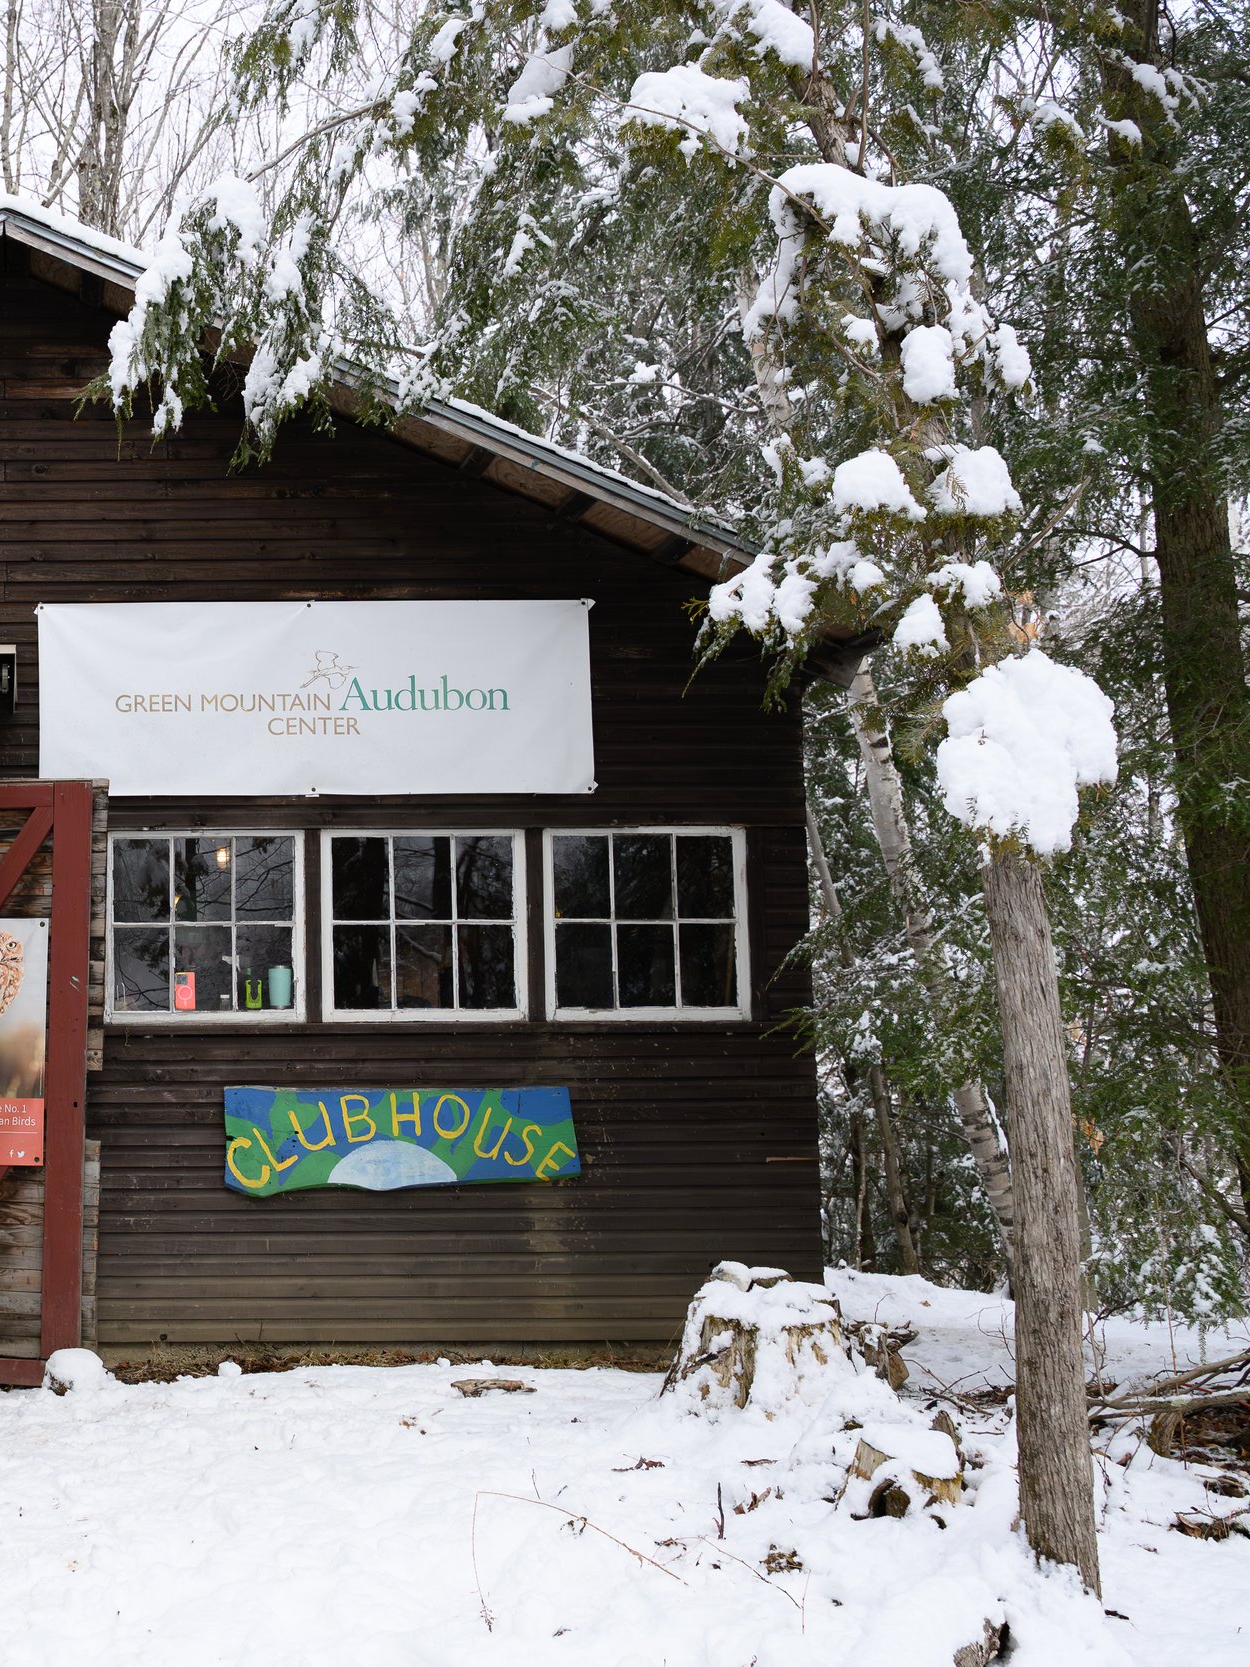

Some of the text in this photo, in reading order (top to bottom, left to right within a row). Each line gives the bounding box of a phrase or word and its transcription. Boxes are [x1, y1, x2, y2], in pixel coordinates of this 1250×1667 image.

[115, 674, 510, 713] GREEN MOUNTAIN Audubon
[267, 717, 361, 736] CENTER
[4, 1104, 19, 1113] No.
[21, 1104, 27, 1113] 1
[11, 1116, 36, 1127] Birds
[226, 1093, 577, 1189] CLUBHOUSE
